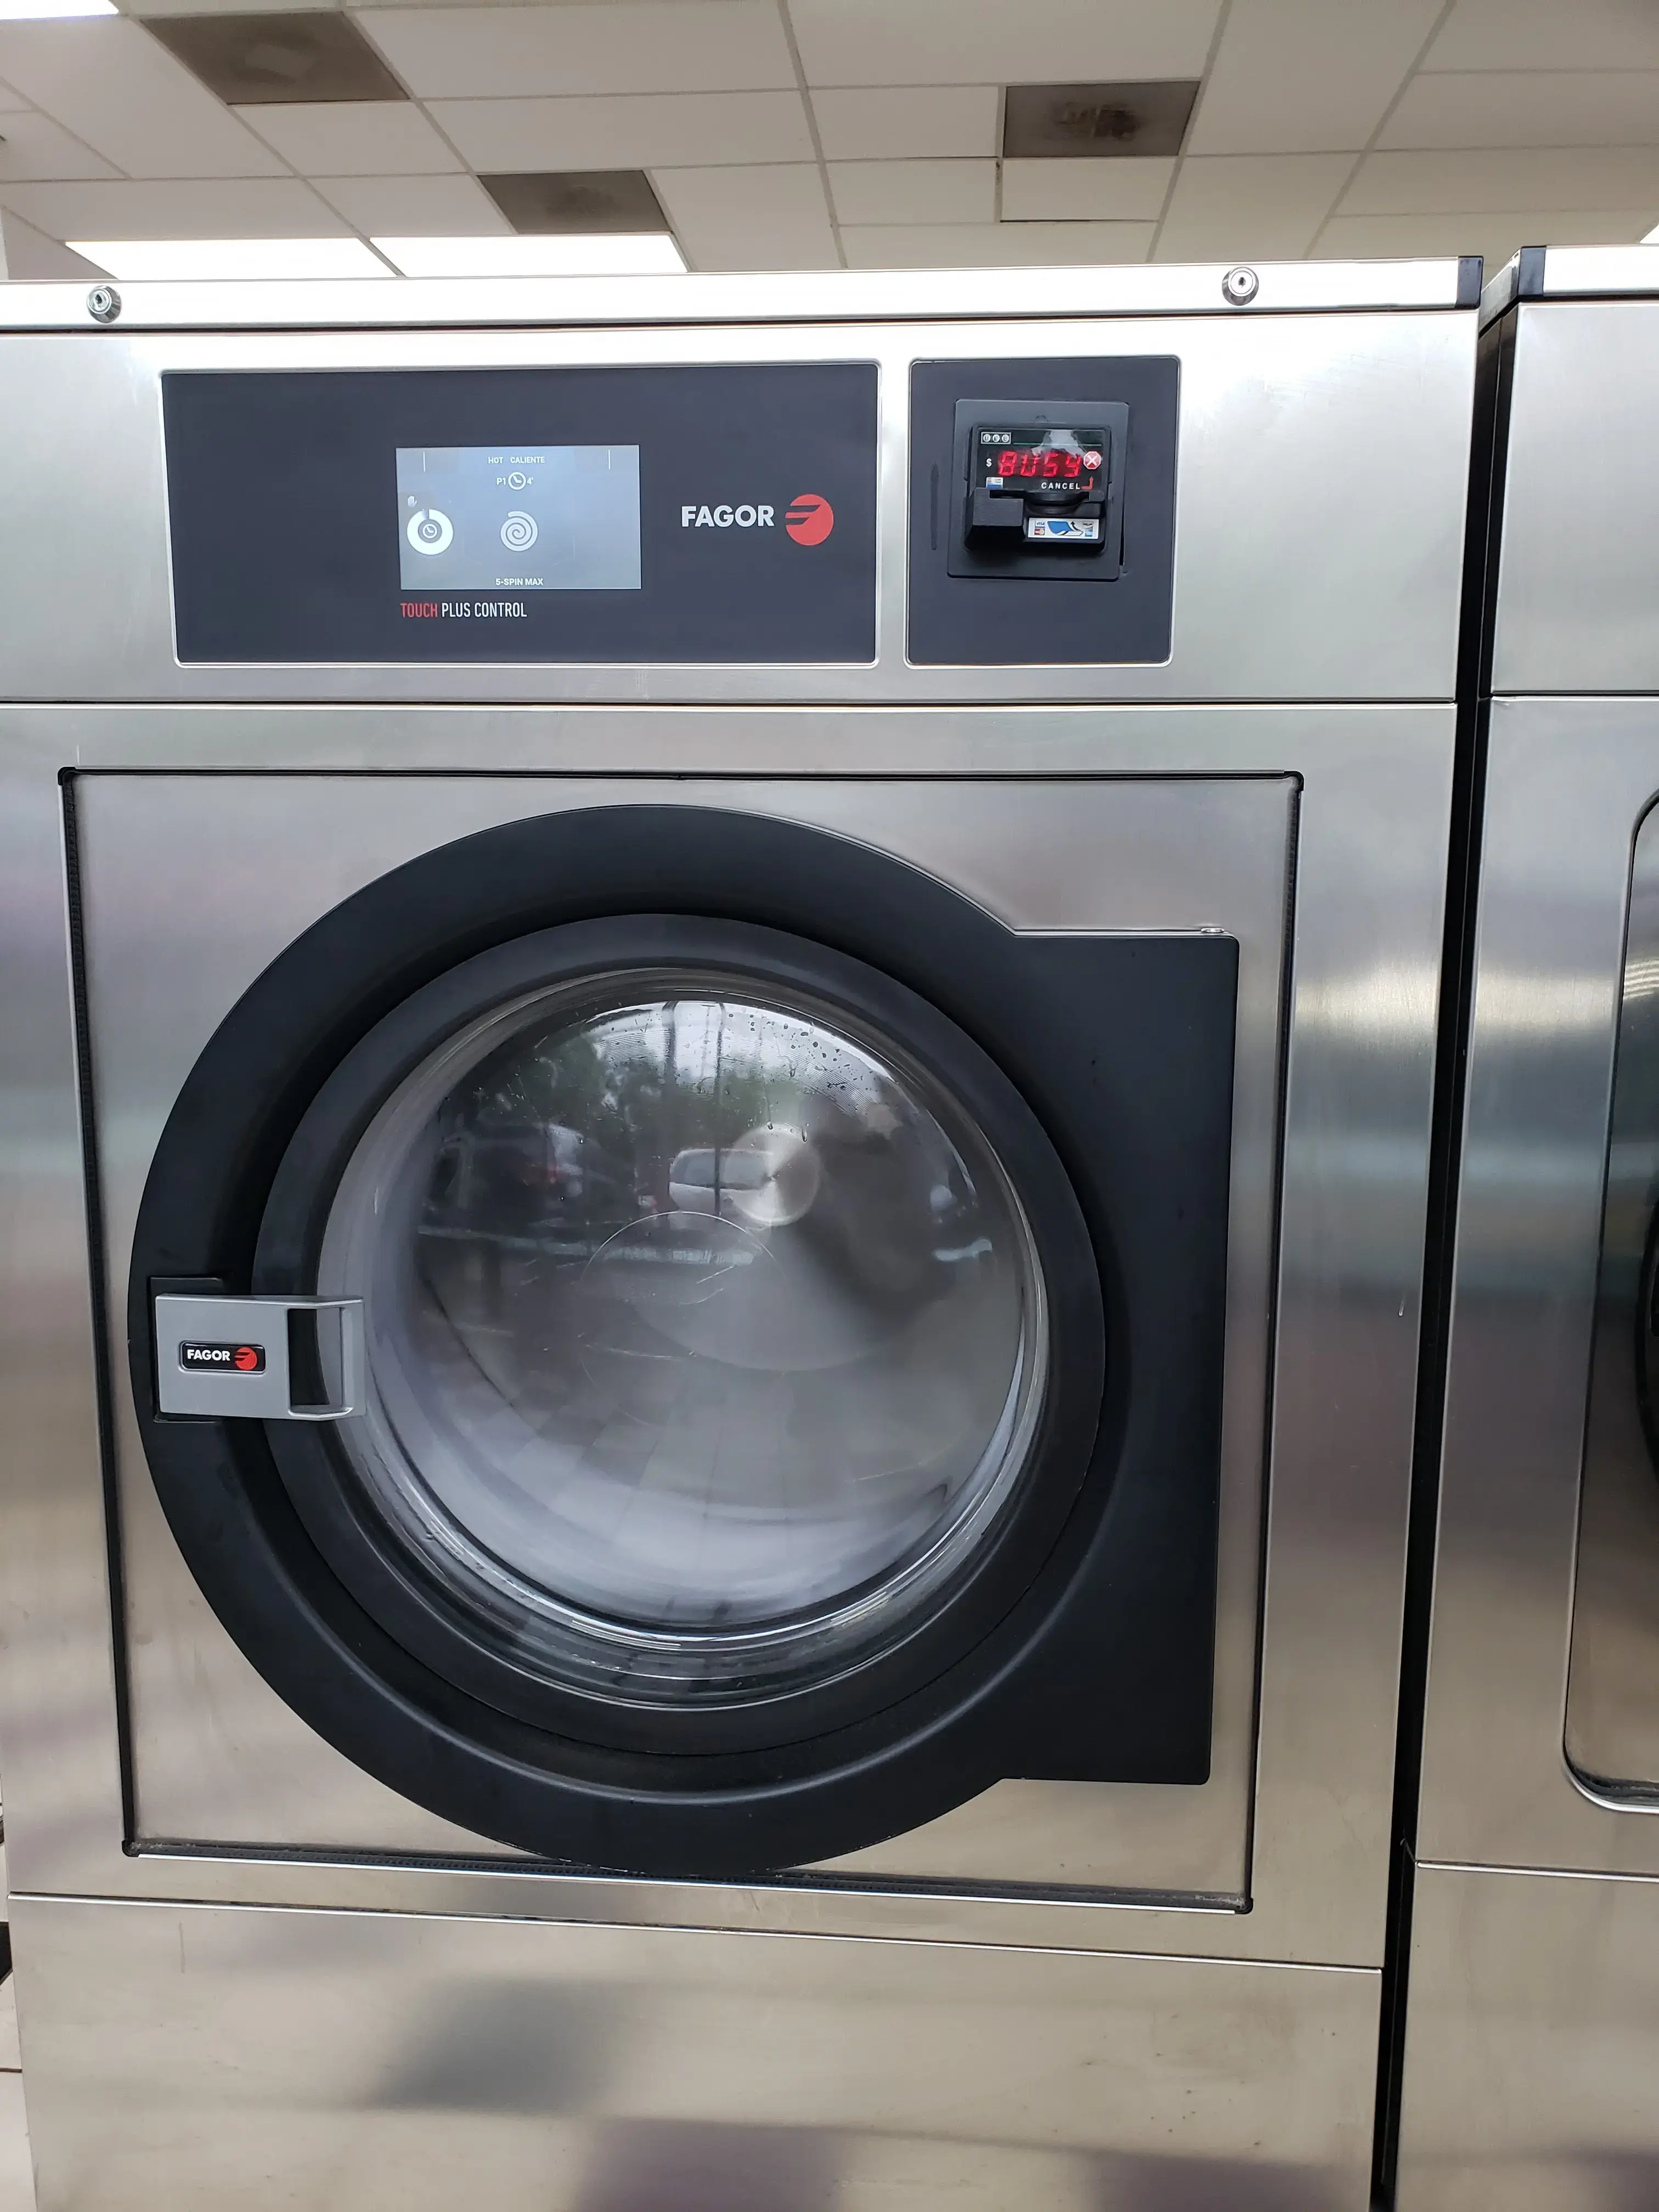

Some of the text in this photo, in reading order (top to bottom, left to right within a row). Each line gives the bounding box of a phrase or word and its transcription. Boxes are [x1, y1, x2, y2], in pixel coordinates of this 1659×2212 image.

[986, 458, 992, 467] $
[496, 477, 506, 486] P1
[1041, 481, 1081, 490] CANCEL
[681, 505, 775, 527] FAGOR
[495, 578, 544, 586] 5-SPIN MAX
[400, 602, 527, 618] TOUCH PLUS CONTROL
[187, 1349, 230, 1361] FAGOR
